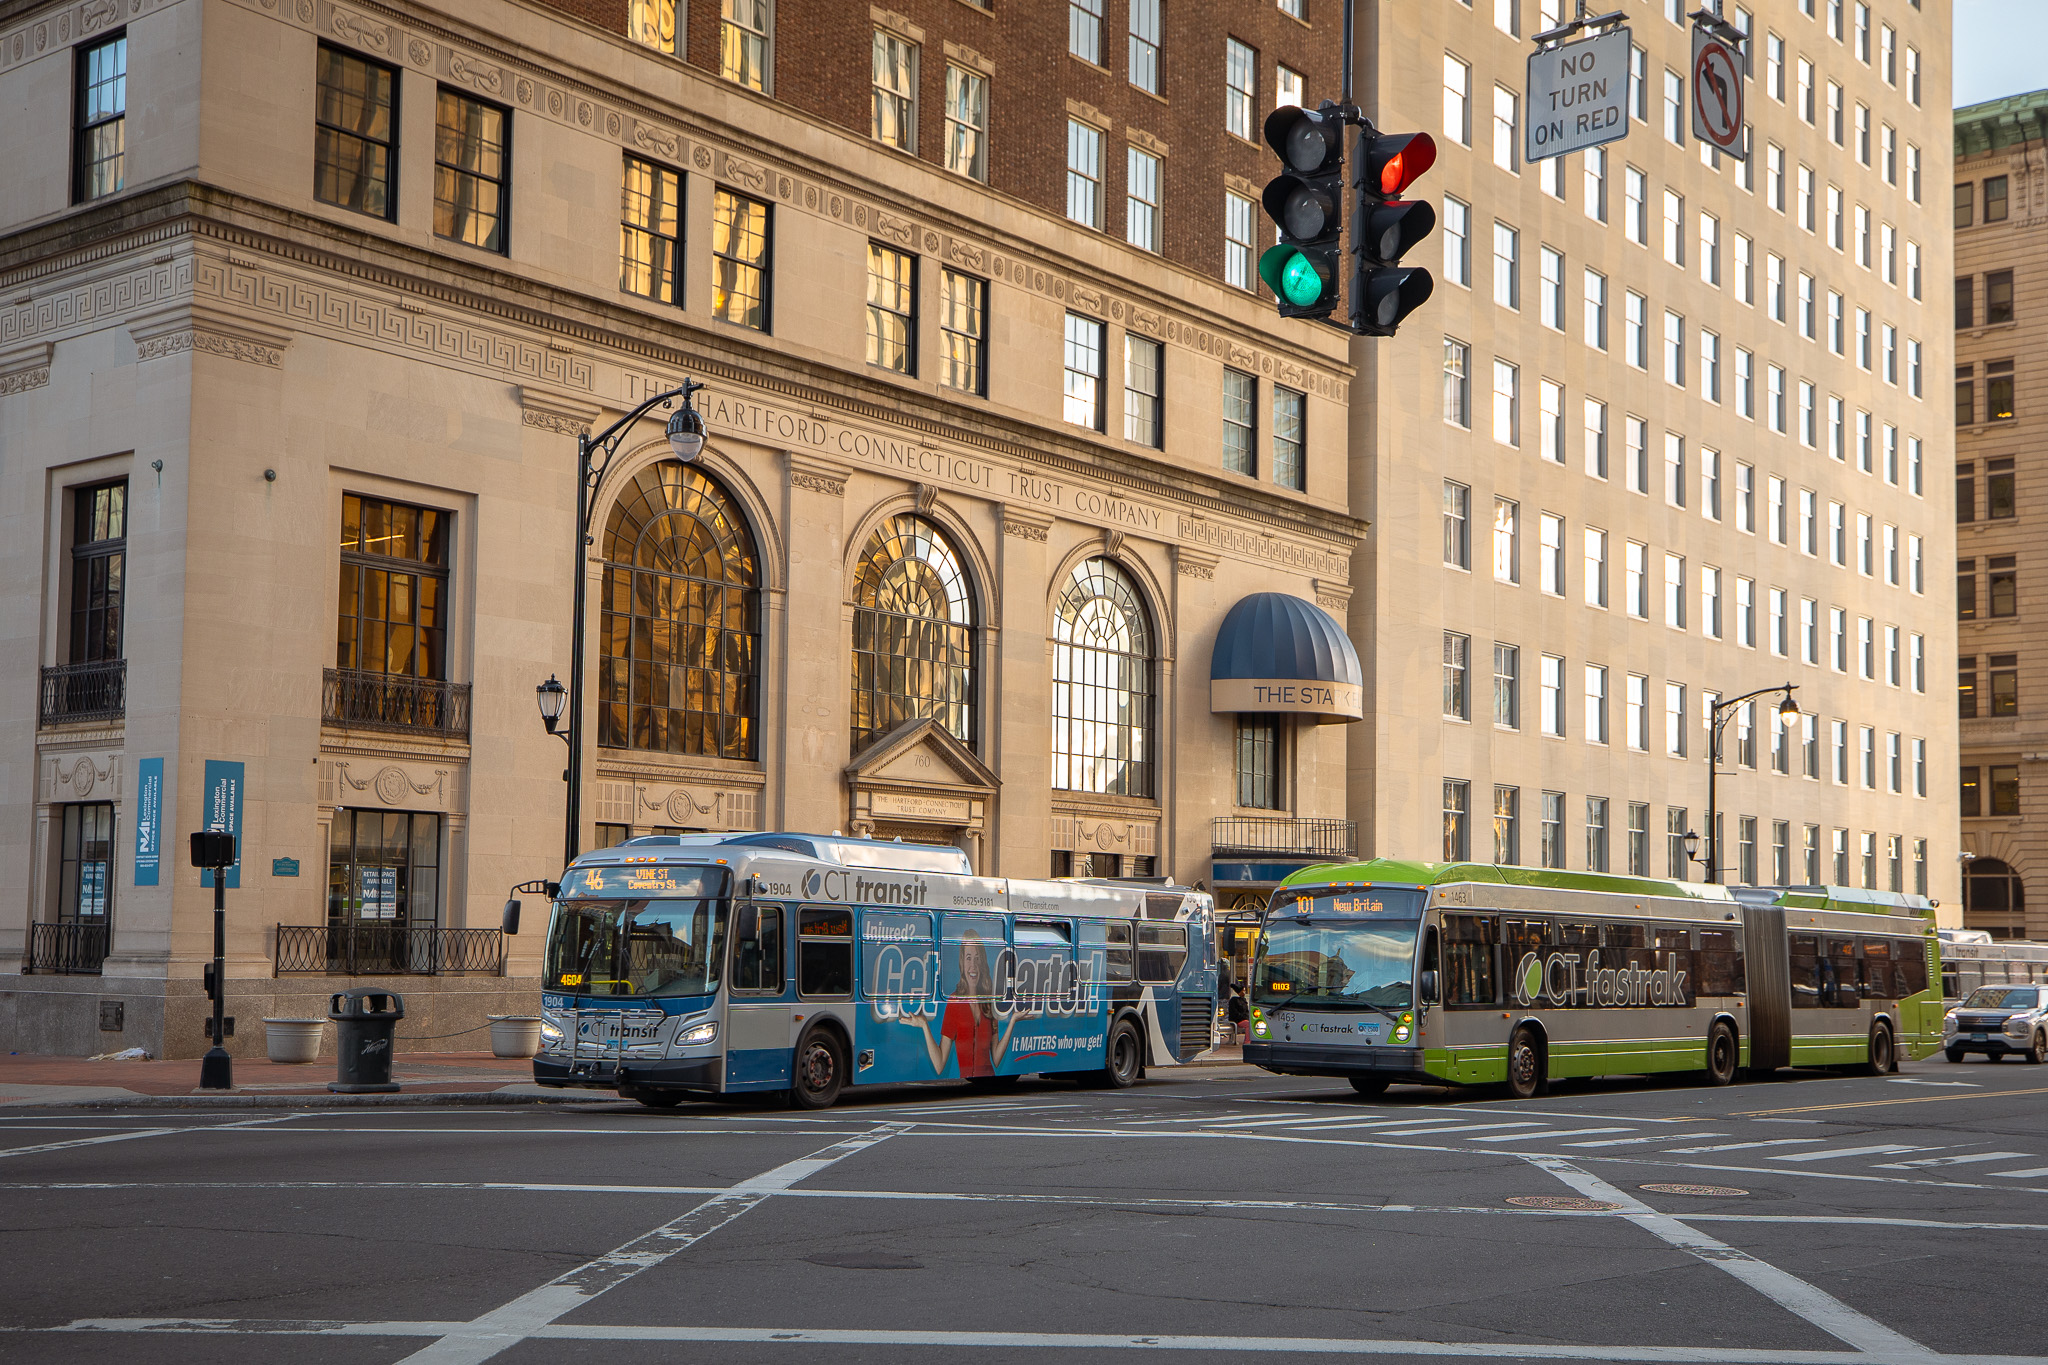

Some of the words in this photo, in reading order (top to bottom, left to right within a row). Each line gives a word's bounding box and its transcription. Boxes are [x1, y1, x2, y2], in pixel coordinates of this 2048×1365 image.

[1561, 52, 1596, 78] NO
[1549, 78, 1607, 111] TURN
[1535, 120, 1564, 145] ON
[1577, 106, 1619, 135] RED
[1007, 472, 1063, 505] TRUST
[1075, 491, 1162, 530] COMPANY
[1254, 686, 1296, 703] THE
[914, 754, 931, 768] 760
[213, 786, 221, 823] Lexington
[219, 778, 227, 824] Commercial
[877, 795, 888, 803] THE
[918, 807, 947, 815] COMPANY
[139, 821, 150, 852] NAI
[585, 869, 604, 890] 46
[635, 868, 657, 880] VINE
[658, 868, 670, 880] ST
[627, 880, 665, 890] Coventry
[666, 879, 677, 889] St
[769, 882, 792, 896] 1904
[824, 870, 851, 901] CT
[856, 874, 928, 905] transit
[1022, 900, 1060, 911] CTtransit.com
[1296, 896, 1314, 913] 101
[1333, 898, 1352, 912] New
[1353, 898, 1383, 912] Britain
[1451, 891, 1467, 903] 1463
[866, 920, 916, 946] Injured?
[1955, 945, 1979, 959] transit
[561, 974, 582, 986] 4604
[874, 944, 940, 1020] Get
[991, 948, 1104, 1020] Carter!
[1545, 952, 1580, 1006] CT
[1585, 949, 1686, 1006] fastrak
[1272, 982, 1290, 991] 0103
[544, 996, 564, 1008] 1904
[1277, 1013, 1296, 1022] 1463
[591, 1022, 607, 1037] CT
[610, 1023, 659, 1038] transit
[1308, 1023, 1319, 1033] CT
[1320, 1024, 1353, 1034] fastrak
[1011, 1036, 1020, 1052] It
[1020, 1035, 1057, 1051] MATTERS
[1058, 1035, 1073, 1049] who
[1073, 1037, 1087, 1052] you
[1087, 1034, 1103, 1051] get!
